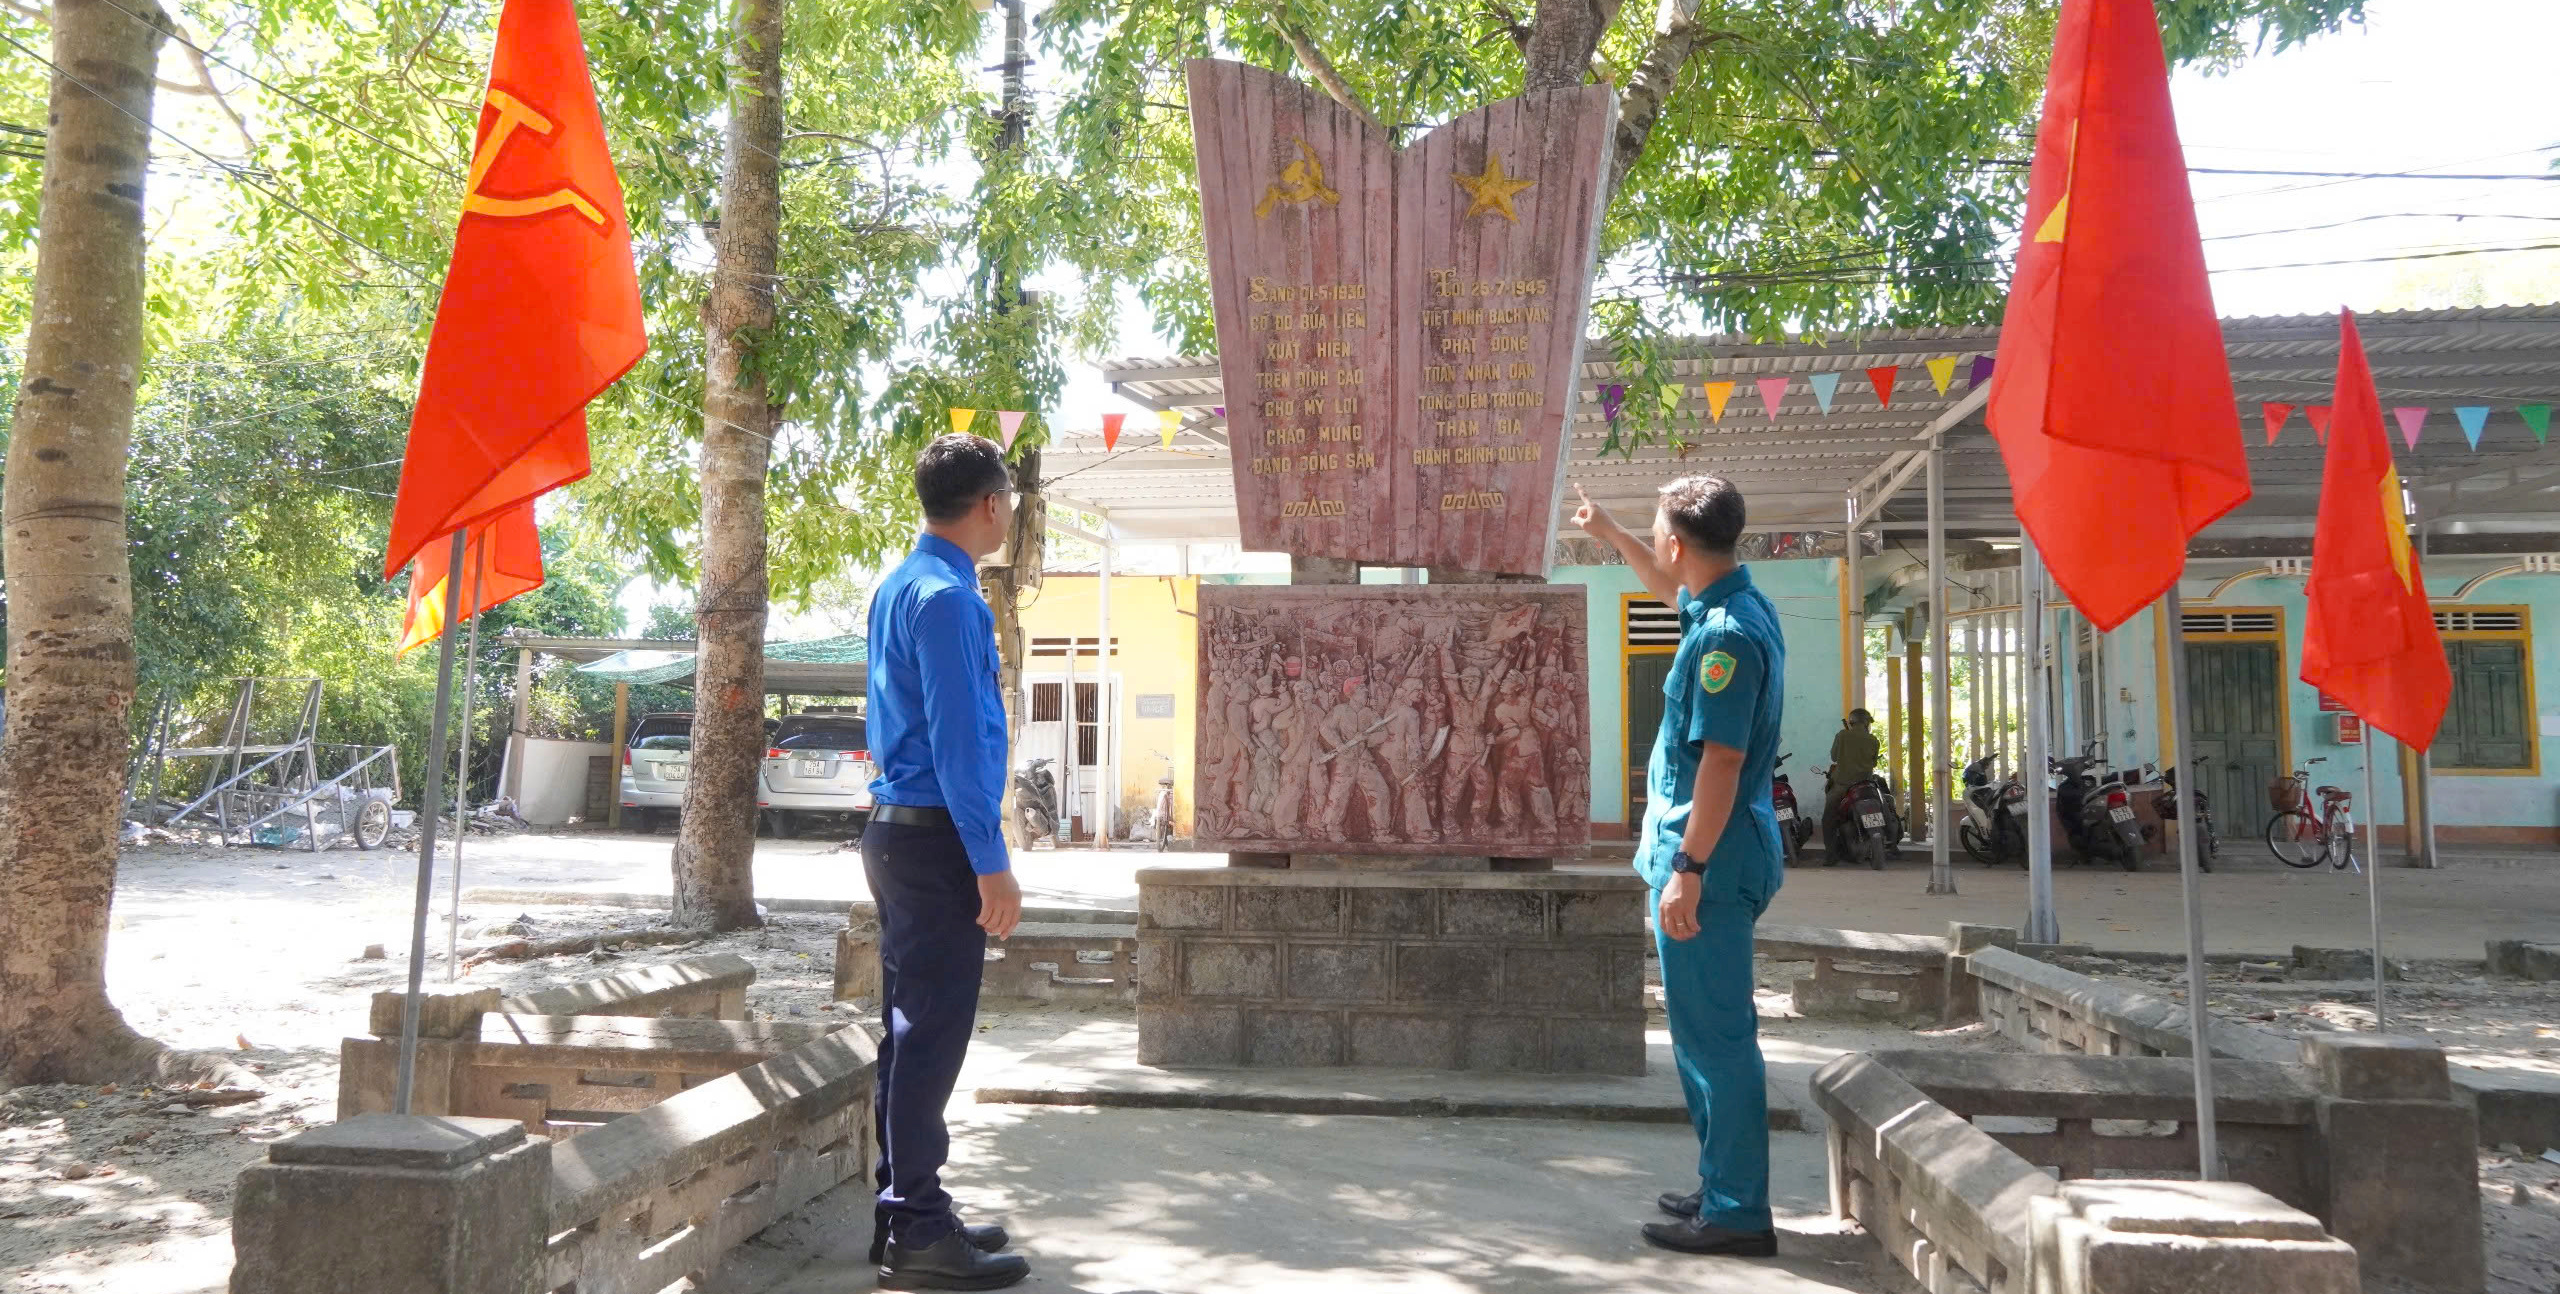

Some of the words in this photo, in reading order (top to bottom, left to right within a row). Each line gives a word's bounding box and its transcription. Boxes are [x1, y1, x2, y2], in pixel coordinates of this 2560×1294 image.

[1452, 309, 1484, 326] MINH
[1337, 369, 1364, 386] CAO
[1436, 420, 1480, 438] THAM
[1497, 418, 1522, 435] GIA
